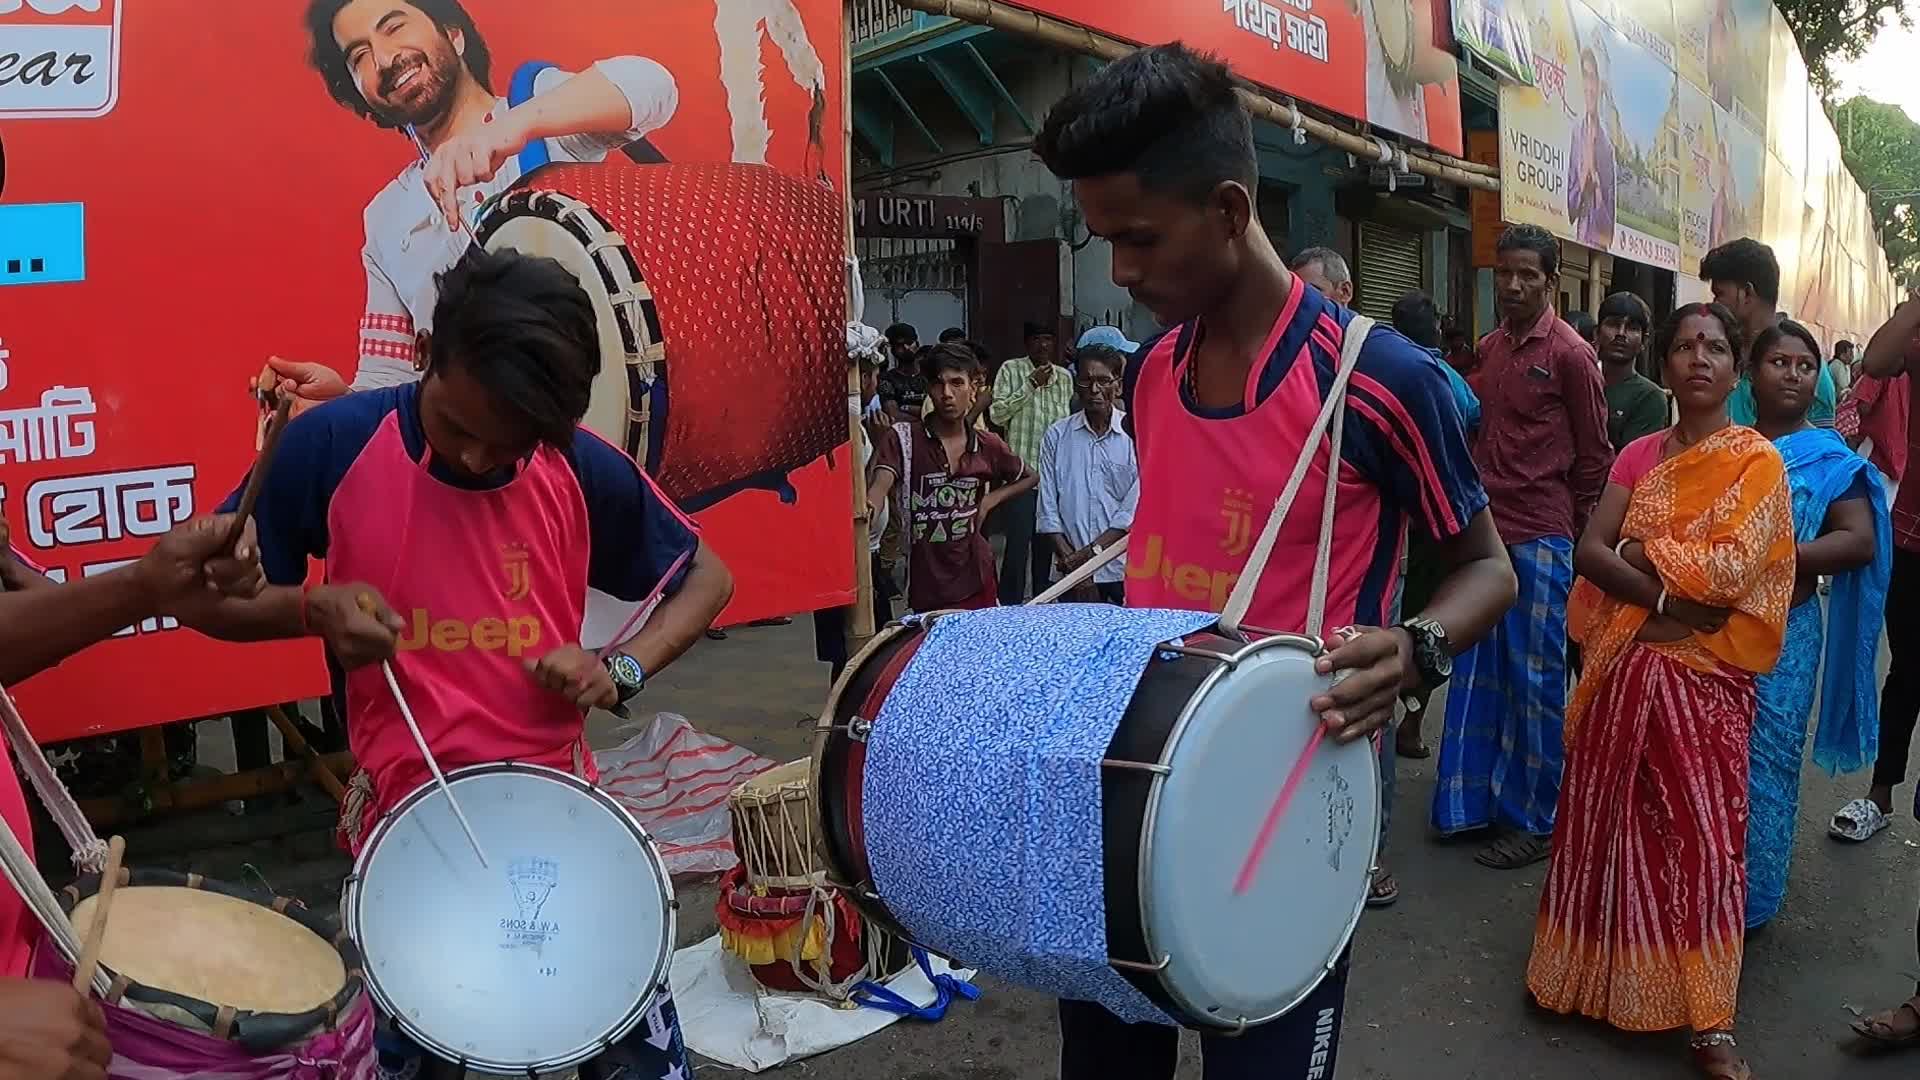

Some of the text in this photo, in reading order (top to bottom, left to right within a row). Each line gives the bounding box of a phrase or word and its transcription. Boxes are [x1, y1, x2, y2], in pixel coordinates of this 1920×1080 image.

[1284, 11, 1329, 63] সাথী
[1517, 160, 1562, 194] GROUP
[26, 465, 195, 548] হোক
[396, 608, 541, 657] Jeep
